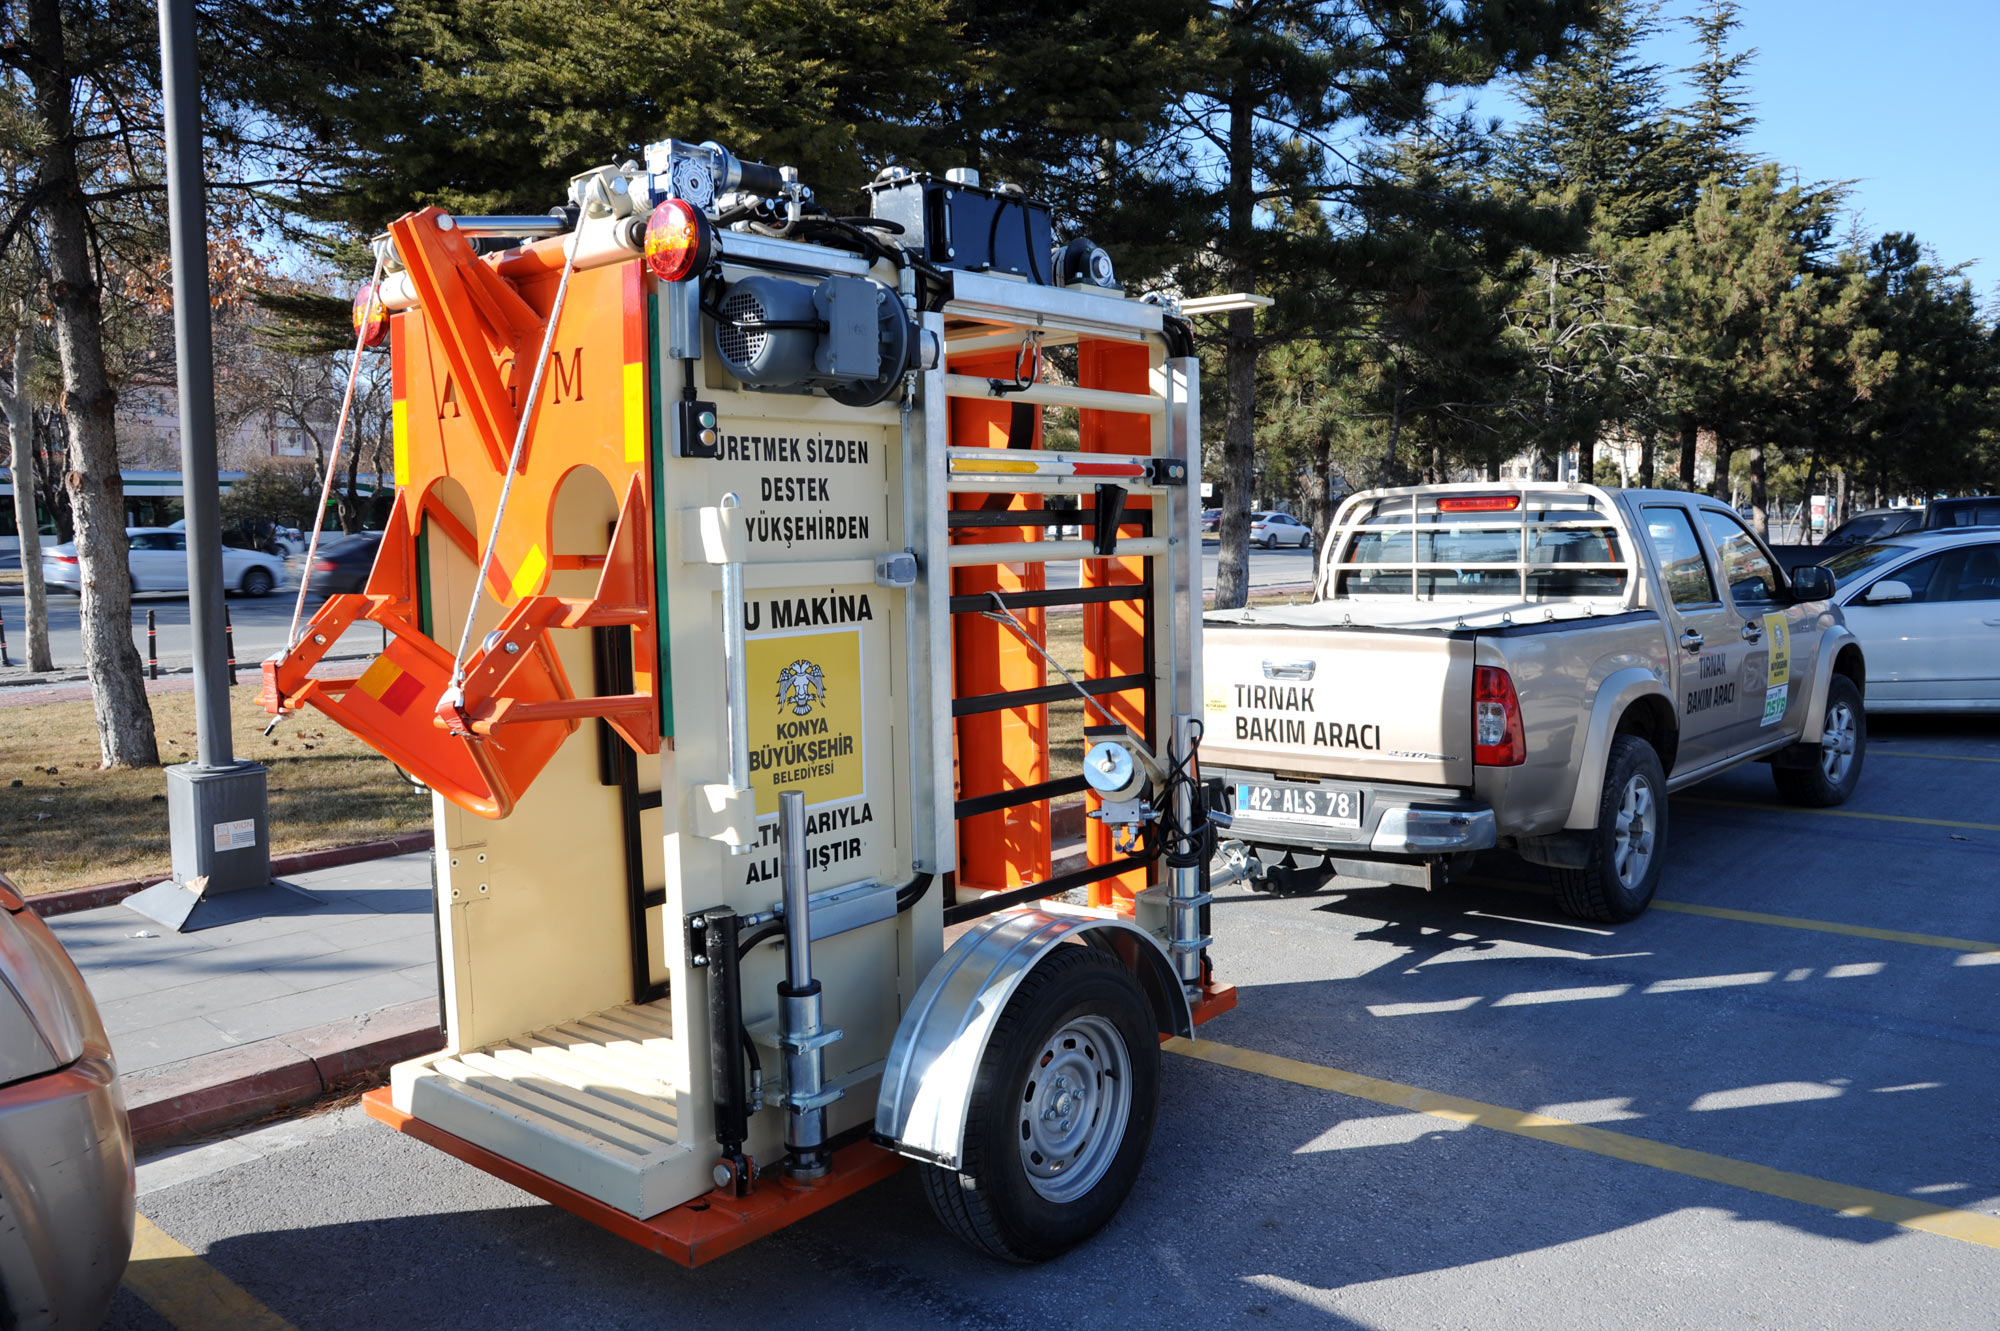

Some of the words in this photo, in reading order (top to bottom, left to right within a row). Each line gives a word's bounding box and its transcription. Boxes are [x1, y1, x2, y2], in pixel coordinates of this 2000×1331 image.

[806, 432, 869, 464] SİZDEN
[761, 477, 830, 502] DESTEK
[745, 509, 869, 548] YÜKŞEHİRDEN
[770, 588, 873, 629] MAKİNA
[1699, 652, 1727, 680] TIRNAK
[1234, 683, 1315, 712] TIRNAK
[1686, 687, 1712, 715] BAKIM
[1713, 682, 1735, 708] ARACI
[776, 717, 829, 740] KONYA
[1235, 715, 1305, 745] BAKIM
[1313, 721, 1381, 750] ARACI
[749, 732, 853, 772] BÜYÜKŞEHİR
[773, 760, 834, 785] BELEDİYESİ
[1250, 786, 1273, 811] 42
[1282, 789, 1316, 814] ALS
[1325, 792, 1350, 818] 78
[751, 802, 873, 848] TKARIYLA
[746, 837, 862, 886] ALIIŞTIR
